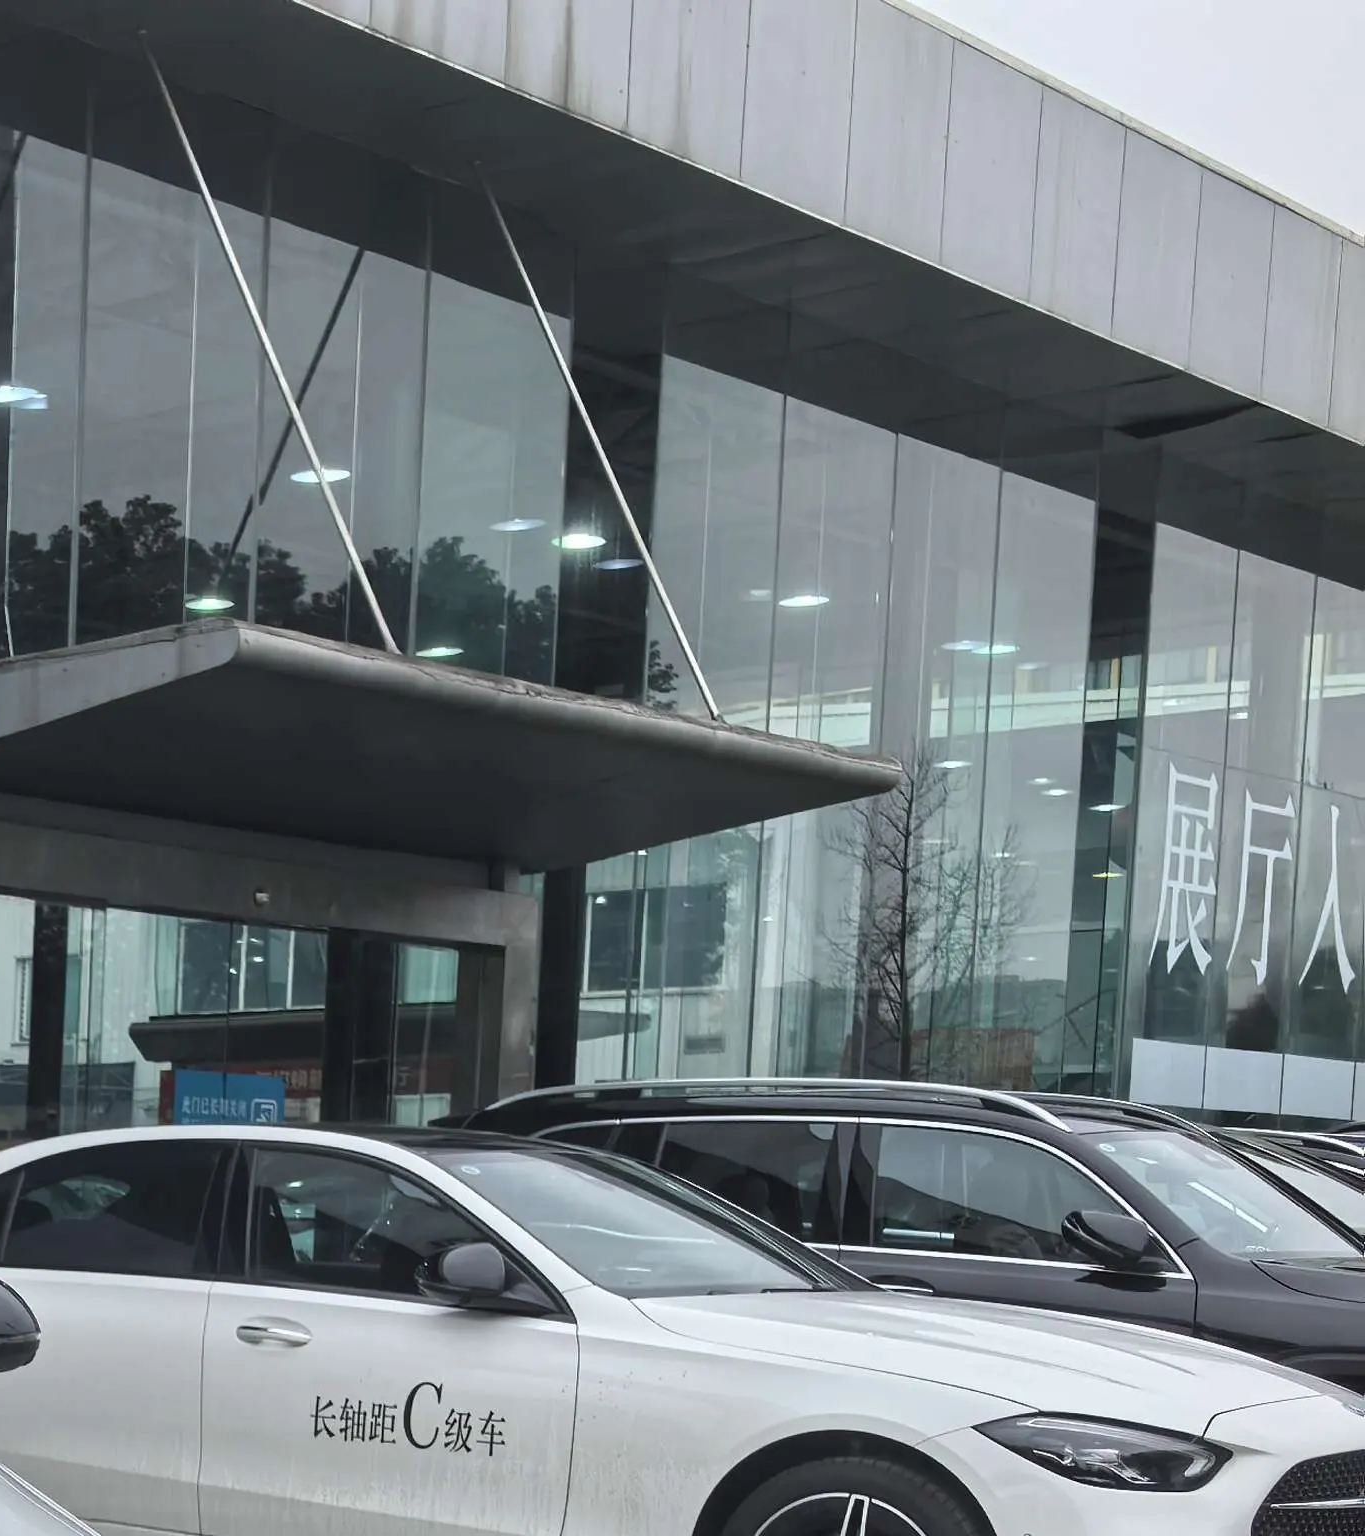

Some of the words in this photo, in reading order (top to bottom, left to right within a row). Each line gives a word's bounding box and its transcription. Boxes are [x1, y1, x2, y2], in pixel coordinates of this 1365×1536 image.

[1148, 761, 1356, 994] 展厅入
[310, 1382, 506, 1456] 长轴距C级车
